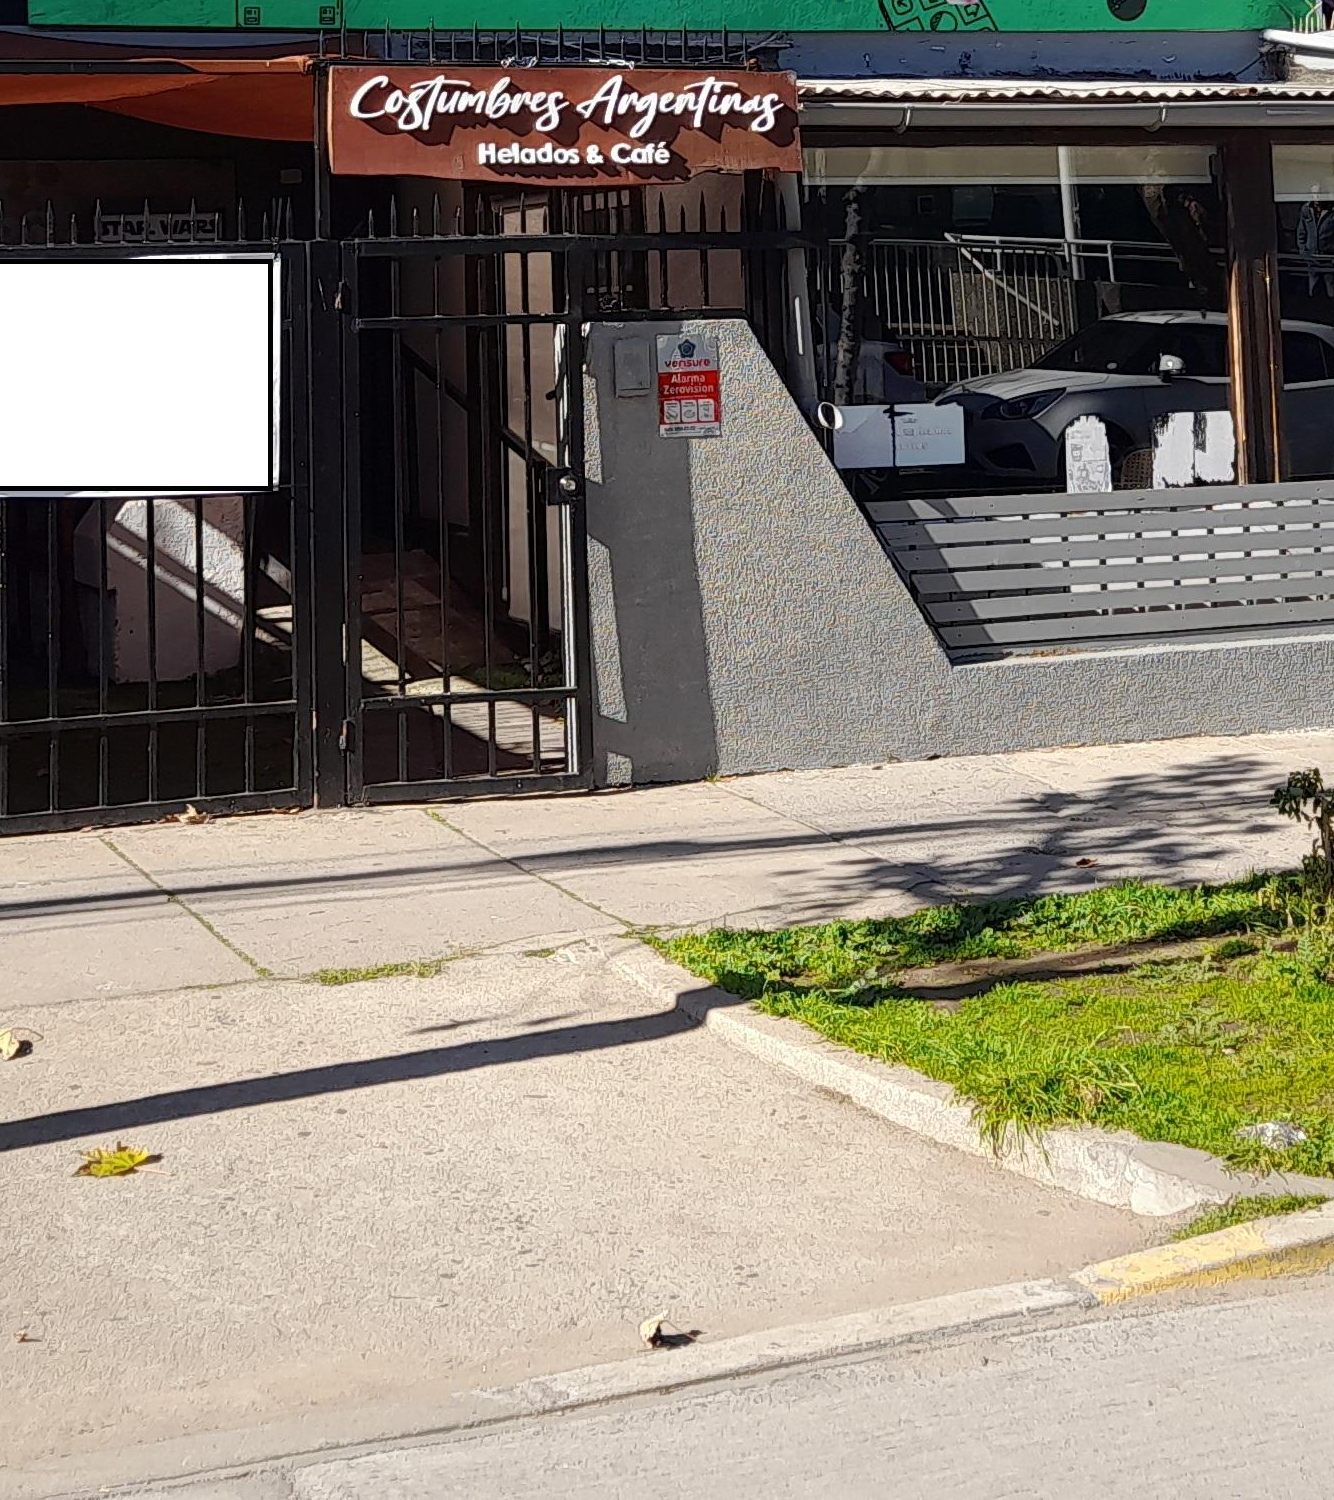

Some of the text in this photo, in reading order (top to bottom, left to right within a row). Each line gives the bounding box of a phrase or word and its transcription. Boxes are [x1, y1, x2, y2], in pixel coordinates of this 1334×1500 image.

[348, 74, 784, 139] Costumbres Argentinas
[478, 140, 671, 166] Helados & Café
[671, 373, 706, 384] Alarma
